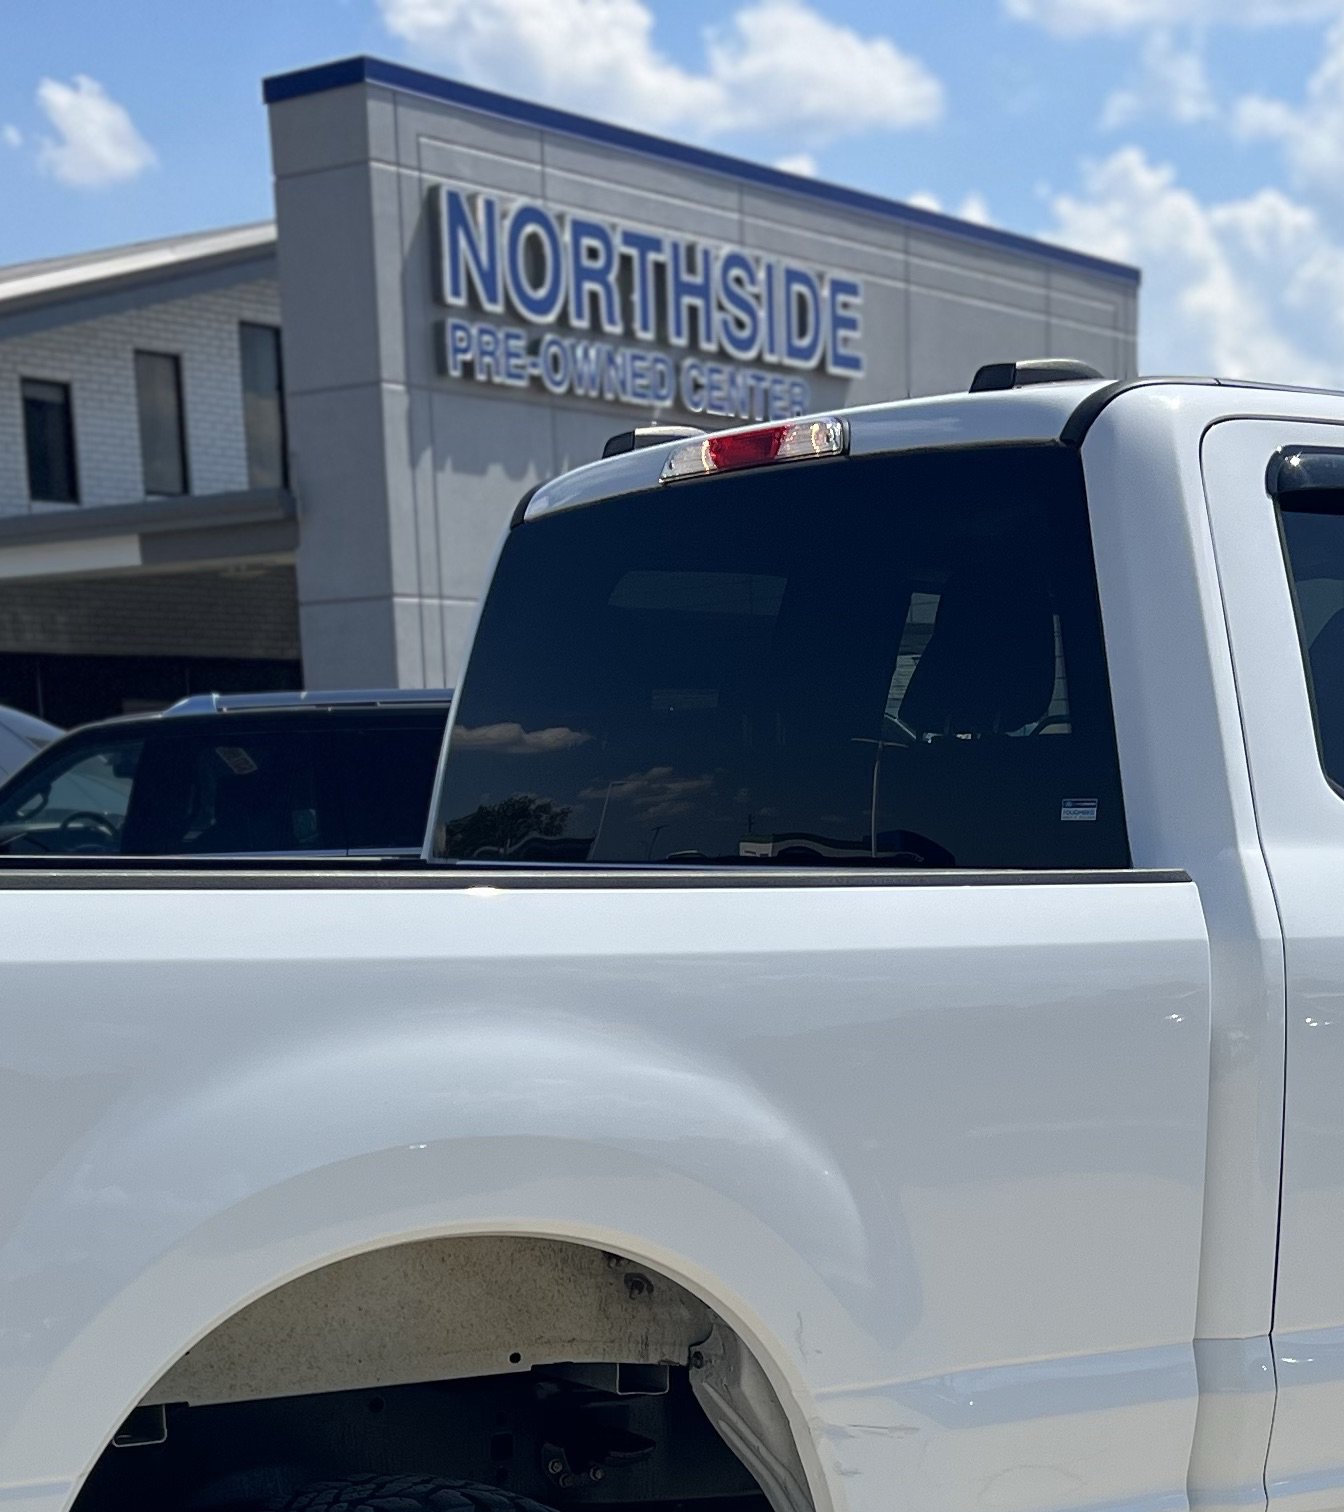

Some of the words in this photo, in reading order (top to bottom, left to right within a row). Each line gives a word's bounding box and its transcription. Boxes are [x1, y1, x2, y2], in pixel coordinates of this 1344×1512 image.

[443, 187, 865, 376] NORTHSIDE
[446, 318, 676, 408] PRE-OWNED
[681, 356, 811, 421] CENTER
